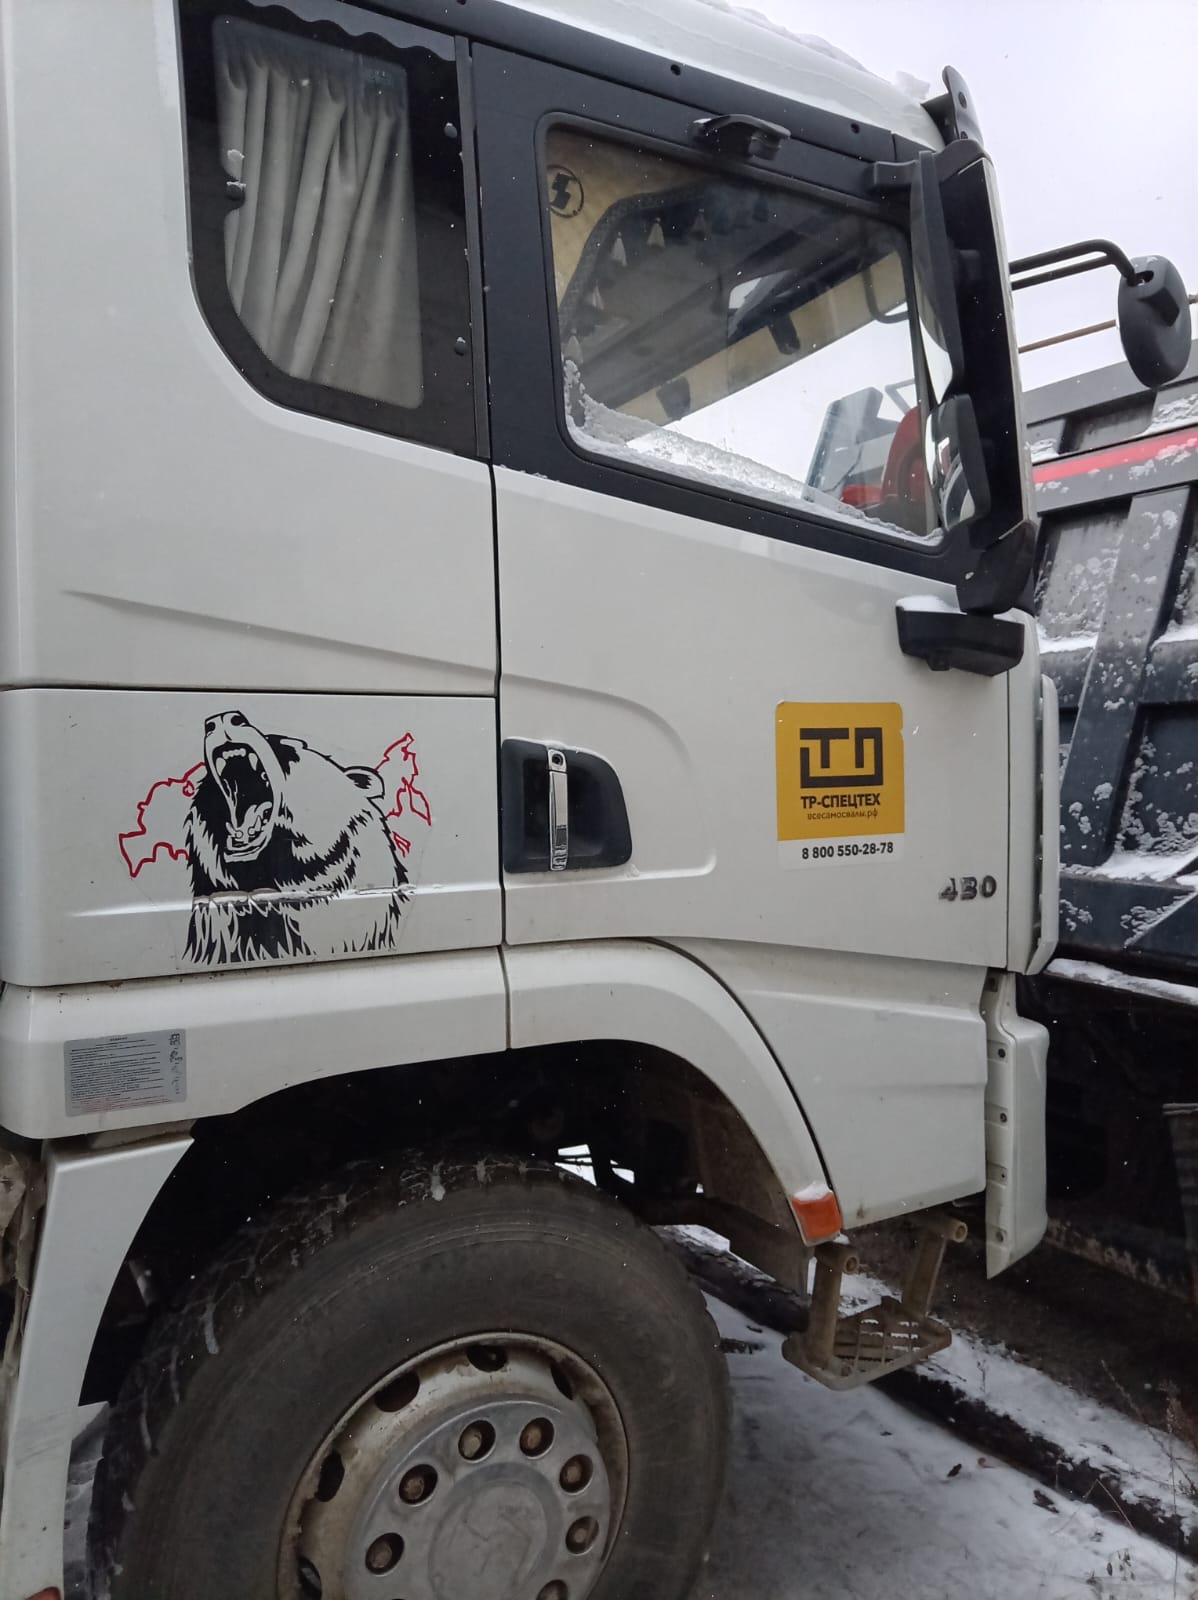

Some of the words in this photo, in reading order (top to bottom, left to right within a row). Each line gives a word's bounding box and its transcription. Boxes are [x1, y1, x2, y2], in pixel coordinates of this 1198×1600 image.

[800, 793, 880, 809] ТР-СПЕЦТЕХ
[807, 808, 878, 820] всесамосвалы.рф
[802, 847, 809, 860] 8
[812, 845, 834, 859] 800
[837, 841, 894, 857] 550-28-78
[939, 875, 997, 902] 430
